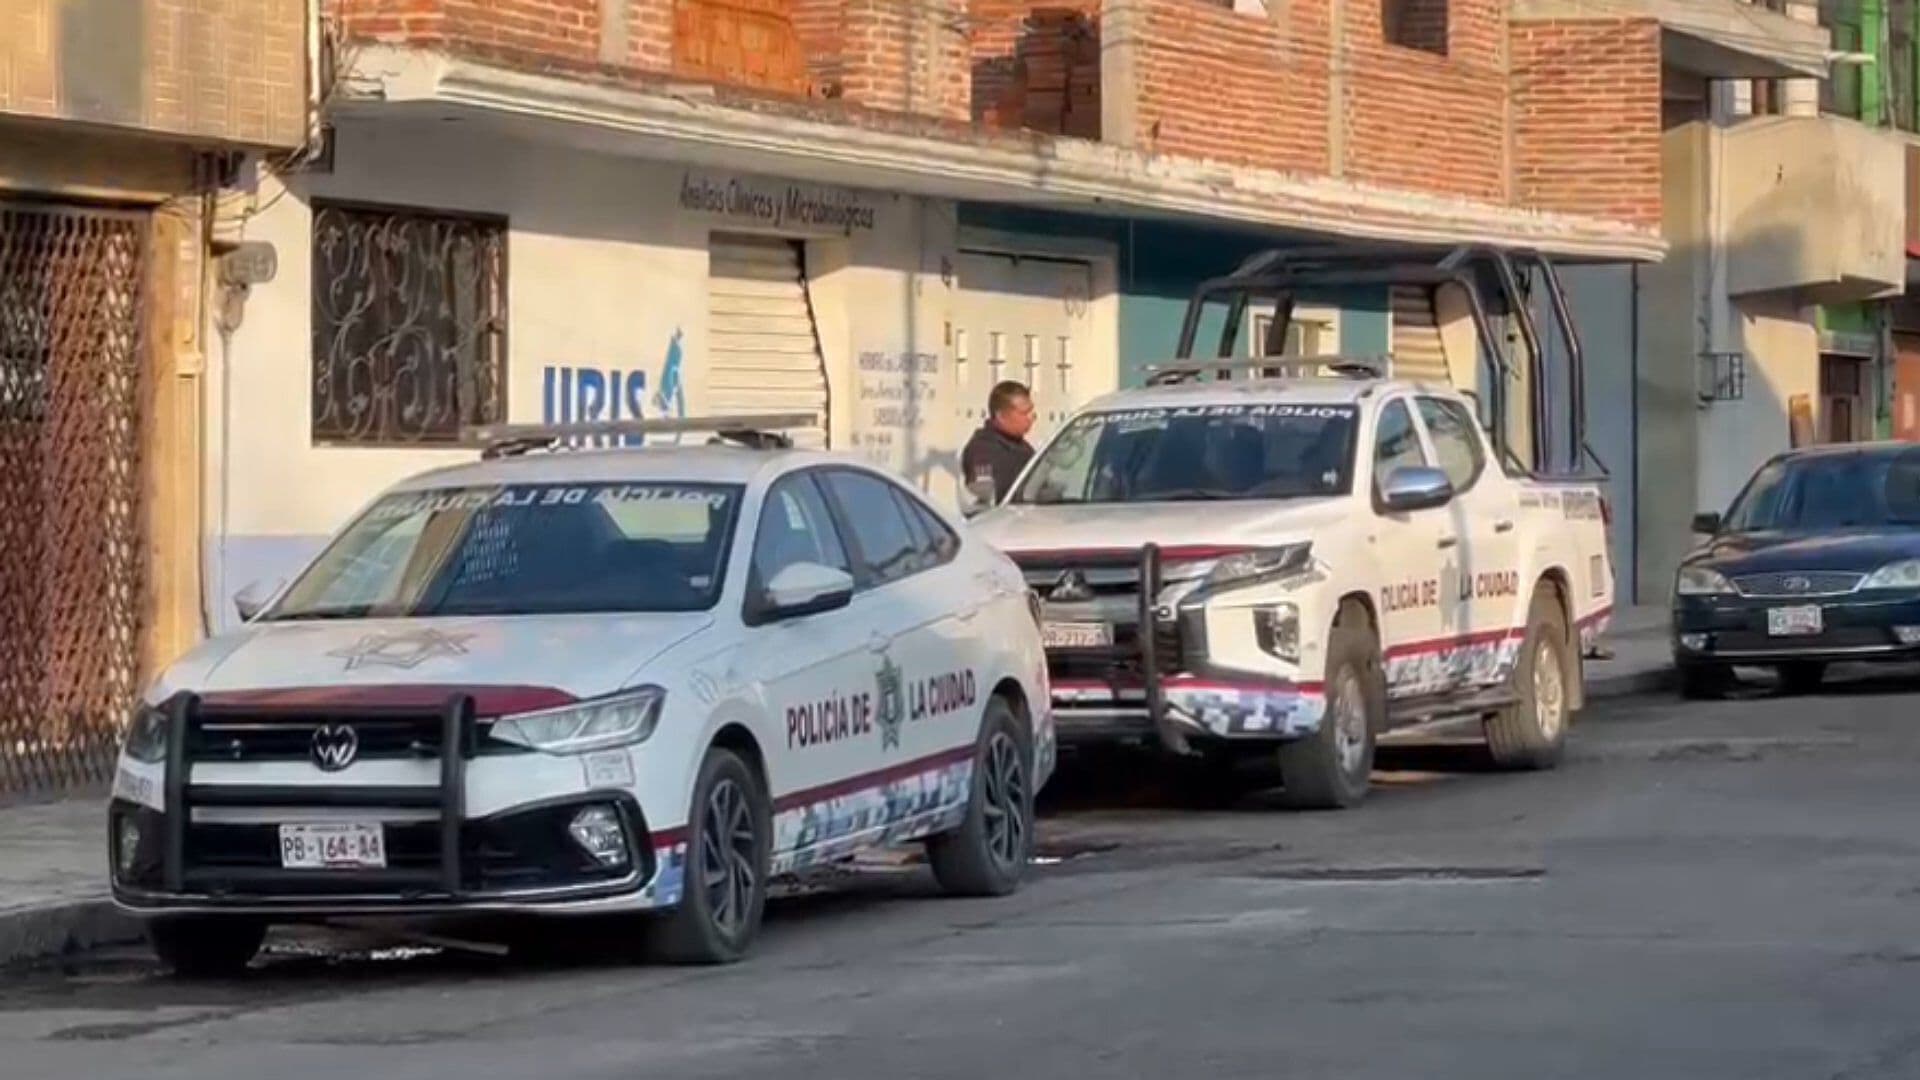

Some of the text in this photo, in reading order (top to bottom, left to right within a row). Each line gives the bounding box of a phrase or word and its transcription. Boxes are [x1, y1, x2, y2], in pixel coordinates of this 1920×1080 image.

[1421, 579, 1438, 605] DE
[1459, 572, 1473, 601] LA
[1476, 570, 1519, 598] CIUDAD
[786, 668, 976, 750] POLICÍA DE LA CIUDAD
